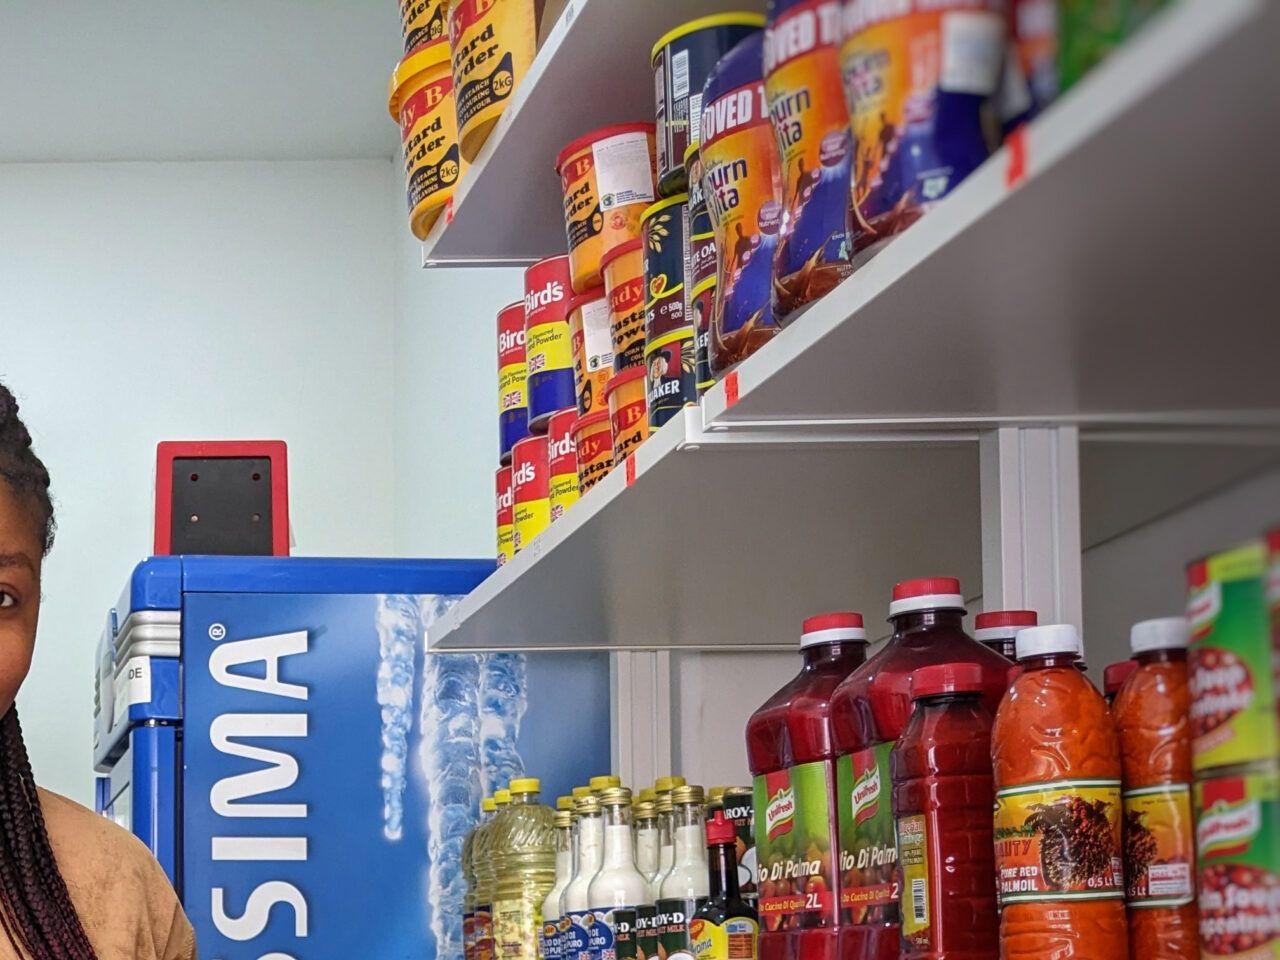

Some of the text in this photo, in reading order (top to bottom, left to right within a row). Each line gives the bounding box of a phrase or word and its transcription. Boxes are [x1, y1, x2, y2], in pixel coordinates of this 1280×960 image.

[493, 76, 513, 91] 2kG
[424, 85, 443, 108] B
[440, 165, 459, 179] 2kG
[576, 158, 591, 177] B
[535, 333, 562, 346] Powder
[626, 405, 641, 422] B
[853, 781, 879, 805] Unifresh
[768, 801, 793, 823] Unifresh
[857, 847, 870, 869] Di
[771, 859, 783, 881] Di
[785, 857, 822, 880] Palma
[1019, 865, 1039, 877] RED
[806, 893, 823, 910] 2L
[667, 924, 685, 933] MILK
